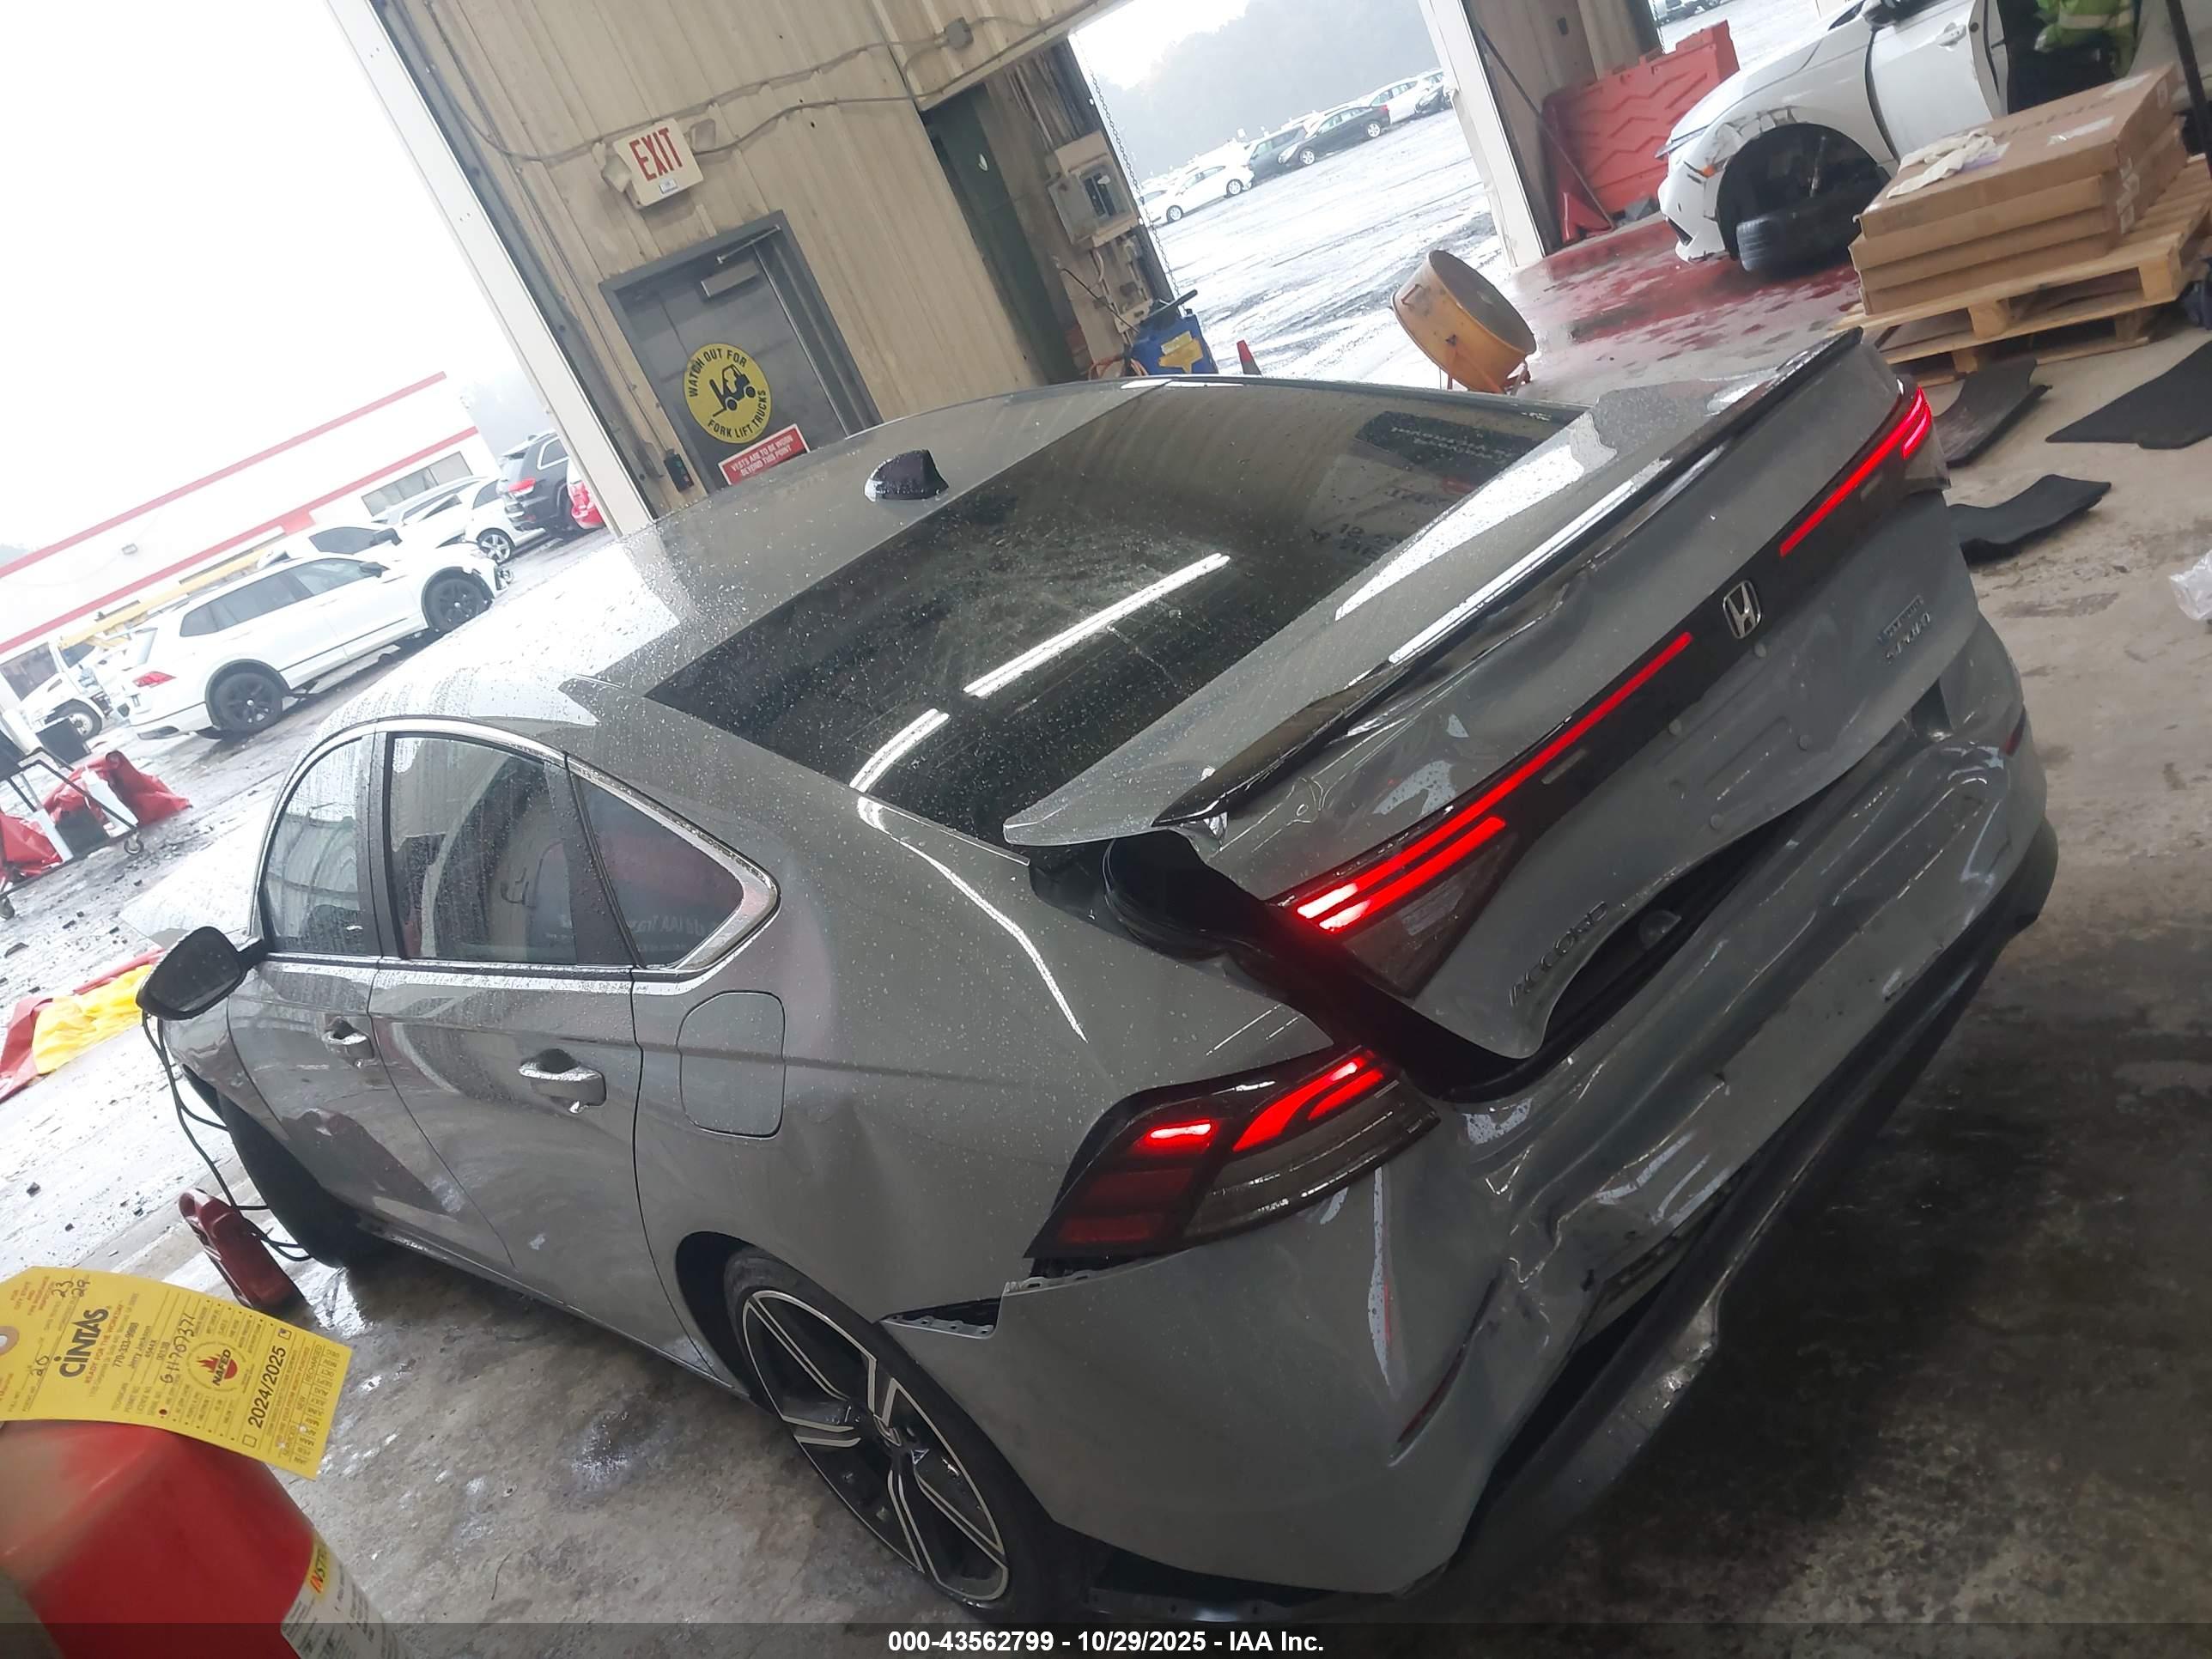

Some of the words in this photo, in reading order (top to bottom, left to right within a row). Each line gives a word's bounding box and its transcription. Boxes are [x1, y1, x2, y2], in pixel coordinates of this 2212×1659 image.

[629, 127, 683, 181] EXIT
[689, 357, 704, 398] WATCH
[703, 348, 722, 362] OUT
[726, 349, 747, 368] FOR
[708, 418, 732, 438] FORK
[734, 424, 753, 439] LIFT
[751, 390, 768, 428] TRUCKS
[759, 447, 769, 457] TO
[775, 445, 792, 458] POINT
[54, 1308, 109, 1377] CINTAS
[84, 1362, 98, 1384] READY
[95, 1346, 105, 1361] FOR
[101, 1333, 111, 1348] THE
[306, 1344, 324, 1382] RECHARGED
[212, 1349, 232, 1386] NAFED
[248, 1346, 286, 1429] 2024/2025
